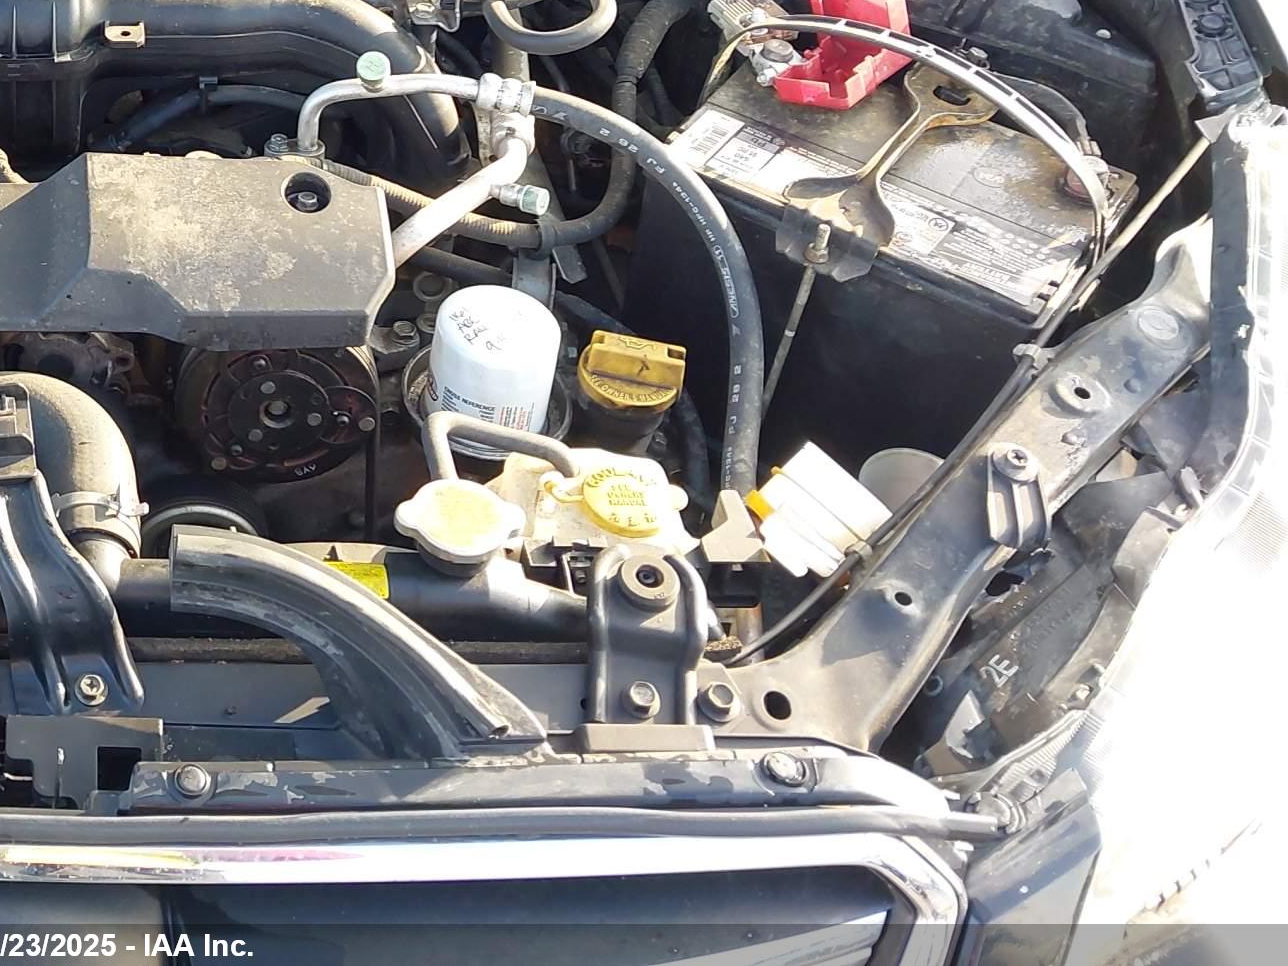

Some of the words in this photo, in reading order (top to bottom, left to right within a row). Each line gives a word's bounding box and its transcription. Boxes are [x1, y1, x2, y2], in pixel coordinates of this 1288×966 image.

[599, 127, 612, 137] 2
[646, 157, 666, 175] FJ
[978, 654, 1020, 689] 2E
